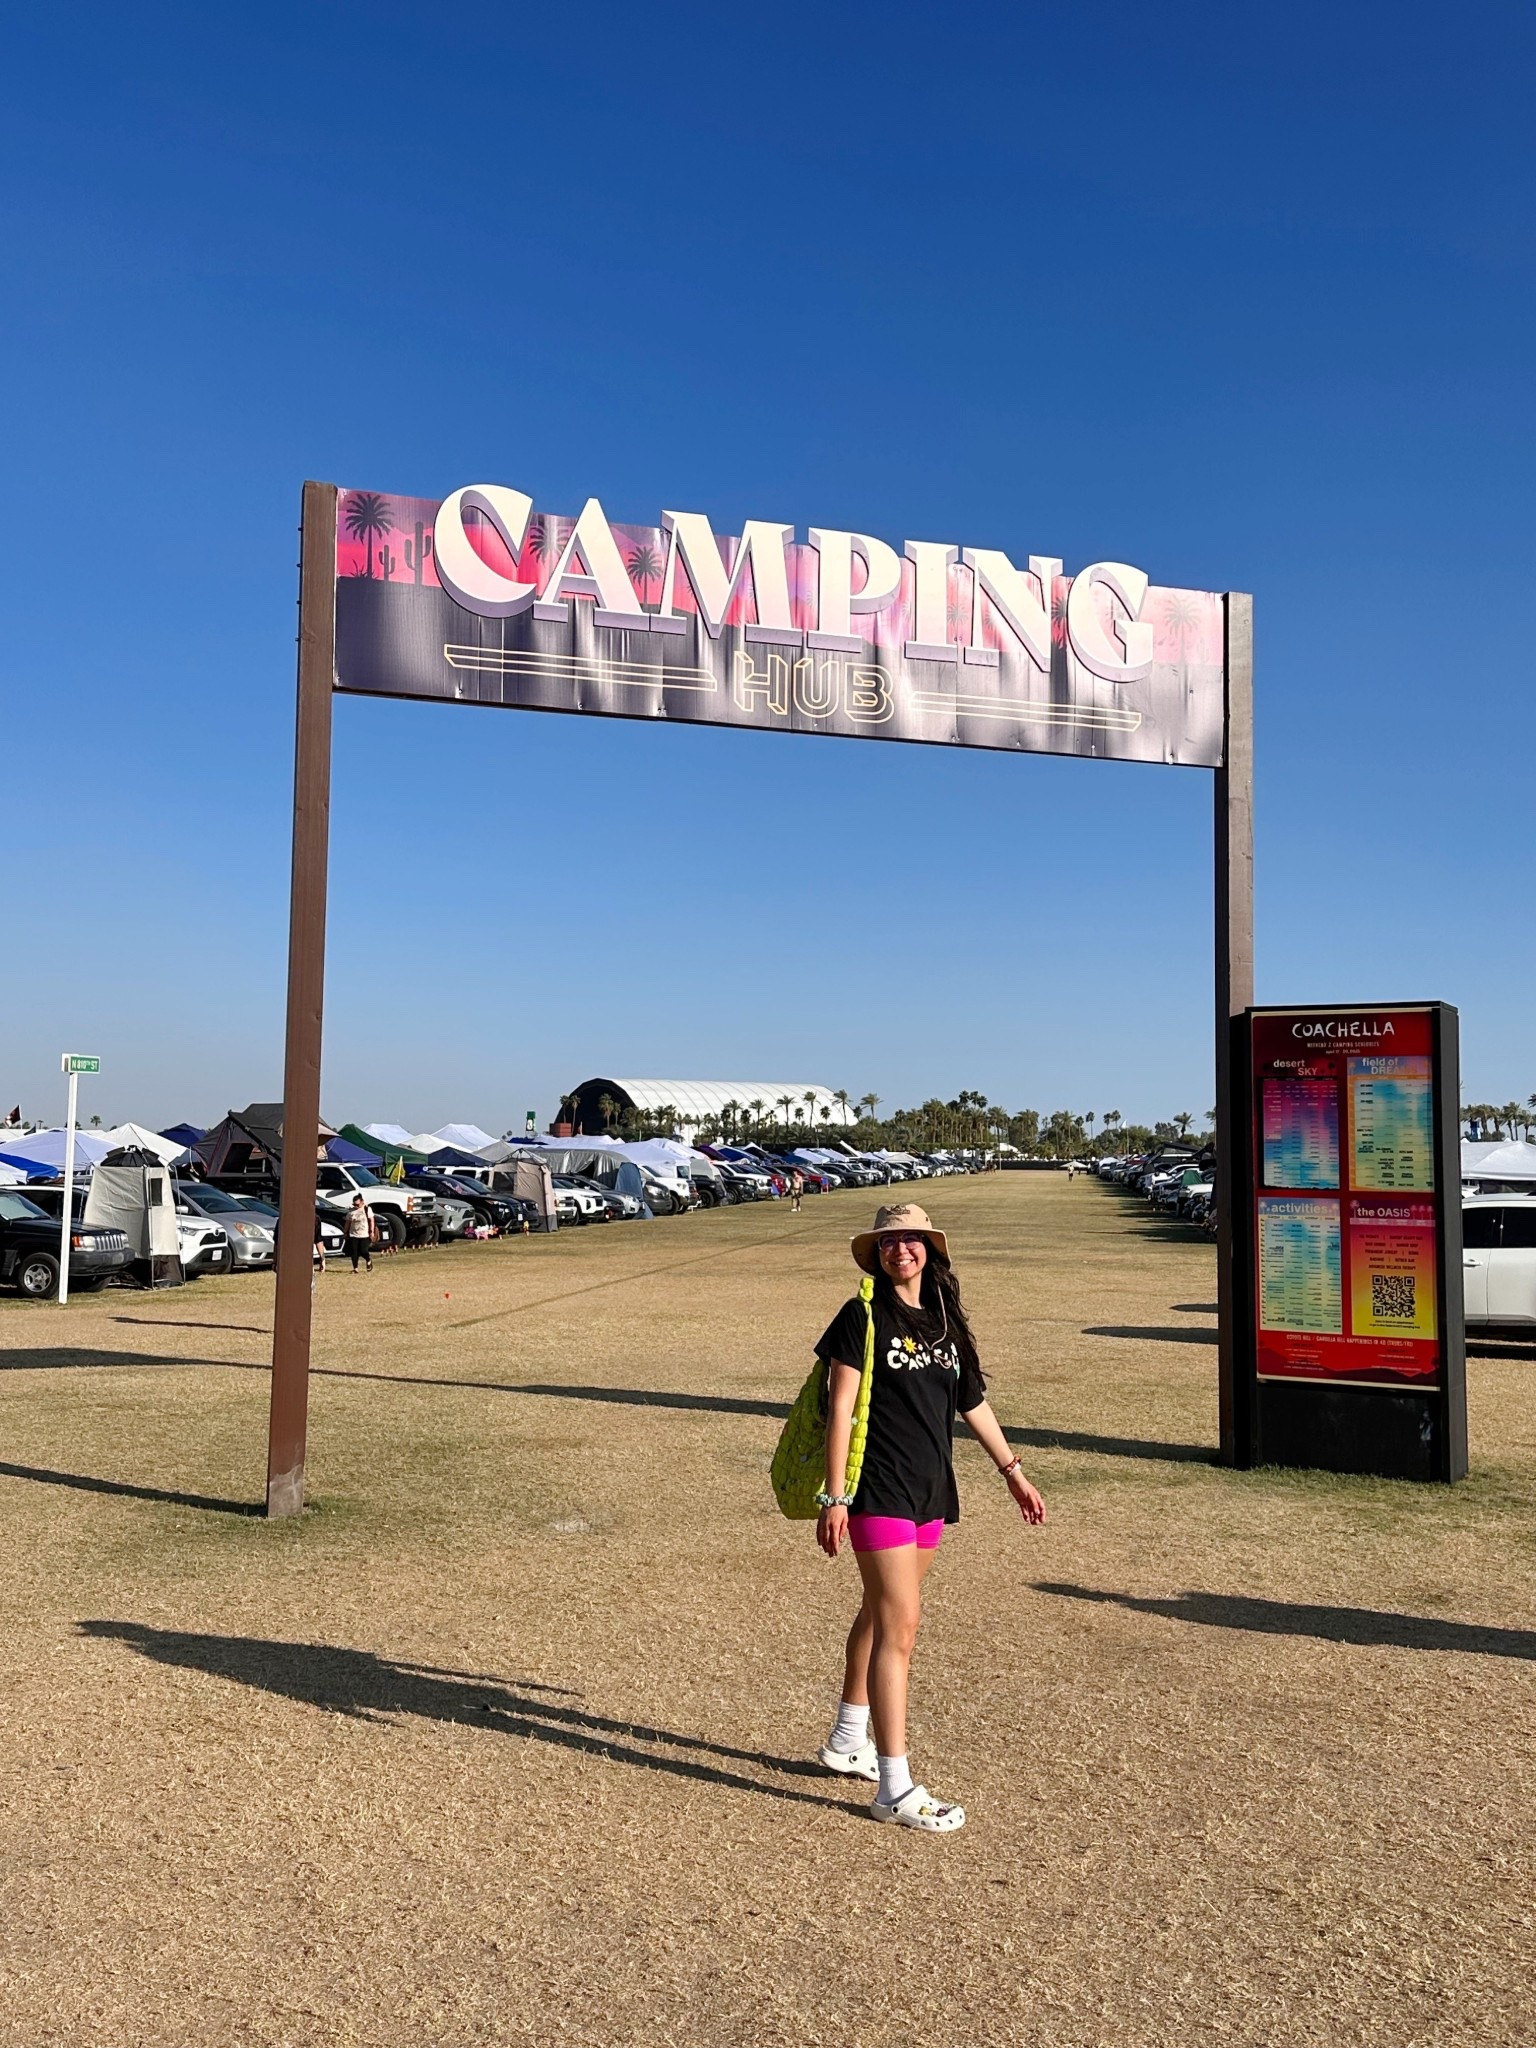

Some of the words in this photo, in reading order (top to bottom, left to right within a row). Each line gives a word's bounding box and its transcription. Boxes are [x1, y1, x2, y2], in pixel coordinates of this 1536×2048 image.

[432, 484, 1154, 684] CAMPING
[734, 651, 895, 723] HUB
[1292, 1021, 1395, 1039] COACHELLA
[72, 1059, 77, 1069] N
[1273, 1059, 1305, 1068] desert
[1362, 1058, 1385, 1066] field
[1388, 1057, 1398, 1066] of
[1297, 1067, 1318, 1076] SKY
[1271, 1203, 1328, 1214] activities
[1357, 1207, 1375, 1217] the
[1377, 1207, 1411, 1218] OASIS
